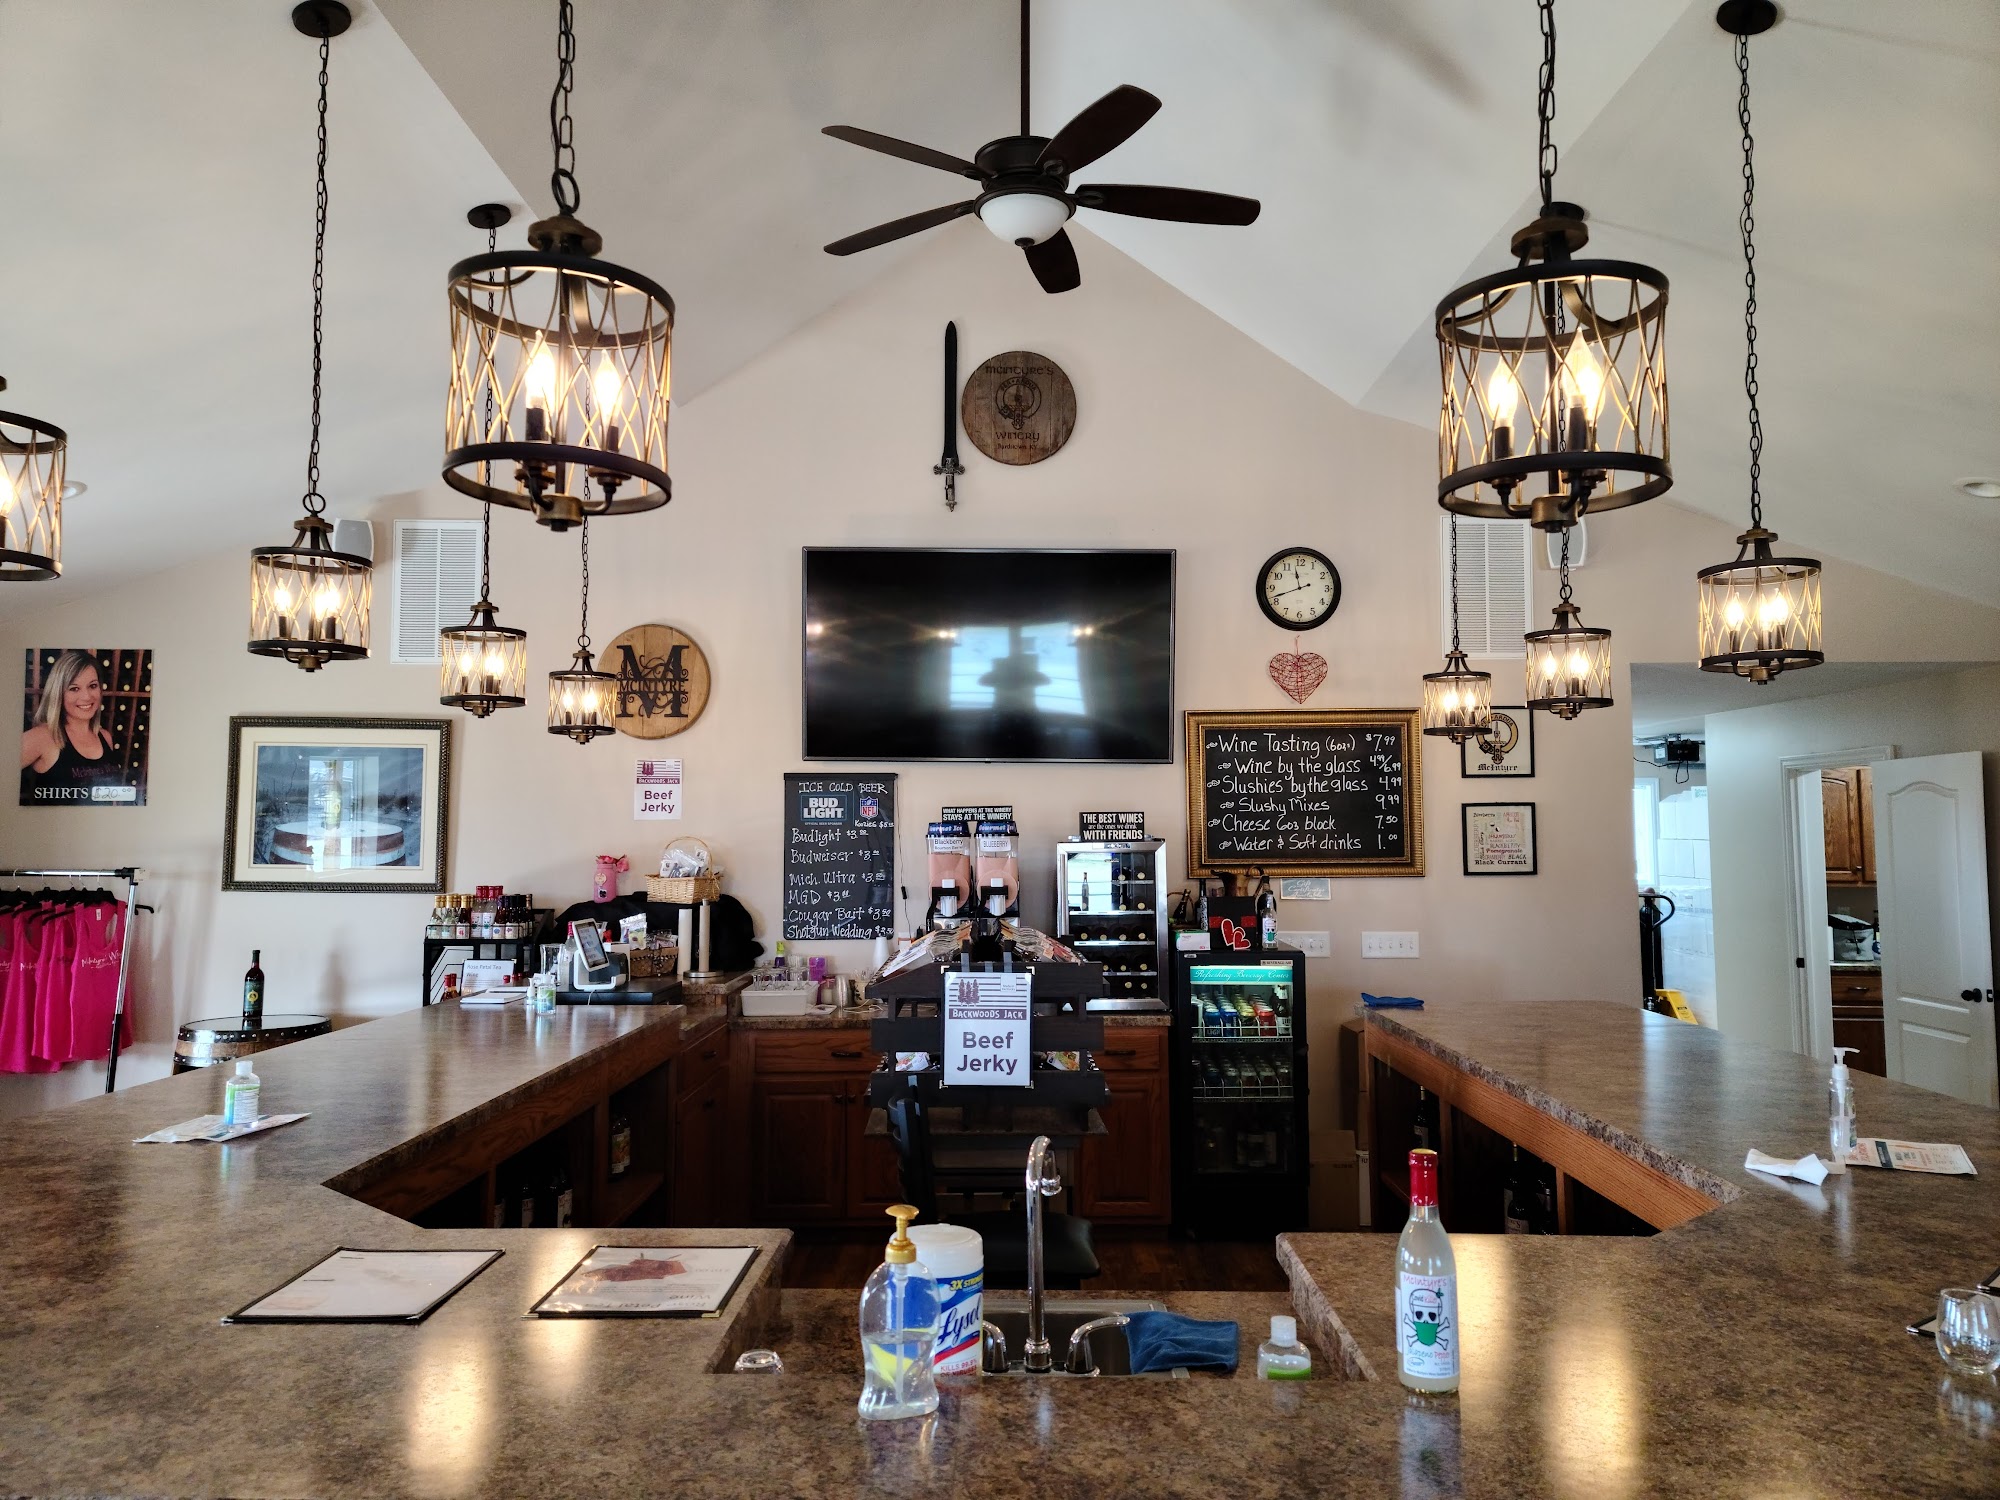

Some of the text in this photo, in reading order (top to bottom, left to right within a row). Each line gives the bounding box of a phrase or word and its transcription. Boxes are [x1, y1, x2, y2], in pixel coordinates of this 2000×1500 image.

[1283, 563, 1291, 571] 11
[1296, 559, 1305, 567] 12
[1311, 562, 1315, 570] 1
[1319, 572, 1326, 580] 2
[619, 680, 686, 692] MCINTYRE
[1217, 733, 1257, 752] Wine
[1263, 732, 1320, 759] Tasting
[1234, 757, 1272, 774] Wine
[1278, 755, 1293, 780] by
[1298, 755, 1321, 773] the
[1325, 756, 1361, 776] glass
[1477, 763, 1518, 772] McIntyre
[798, 782, 888, 794] ICE COLD BEER
[1221, 775, 1283, 794] Slushies
[1330, 775, 1368, 795] glass
[34, 787, 89, 800] SHIRTS
[644, 790, 673, 800] Beef
[641, 802, 675, 814] Jerky
[809, 797, 839, 808] BUD
[1238, 797, 1286, 816] Slushy
[1288, 797, 1330, 812] Mixes
[803, 808, 844, 819] LIGHT
[862, 806, 876, 816] NFL
[943, 813, 963, 821] STAYS
[1083, 813, 1143, 823] THE BEST WINES
[1222, 813, 1270, 832] Cheese
[1304, 814, 1336, 831] block
[791, 827, 841, 847] Budlight
[1083, 830, 1143, 840] WITH FRIENDS
[1233, 835, 1274, 851] Water
[1288, 833, 1317, 850] Soft
[1319, 832, 1362, 850] drinks
[790, 848, 853, 864] Budweiser
[823, 871, 856, 884] Ultra
[787, 889, 821, 905] MGD
[788, 908, 833, 927] Cougar
[834, 906, 865, 920] Bait
[787, 924, 829, 939] Shotgun
[831, 923, 872, 940] Wedding
[1194, 969, 1232, 983] Refreshing
[952, 1009, 1023, 1019] BACKWOODS JACK
[962, 1031, 1014, 1049] Beef
[956, 1054, 1018, 1076] Jerky
[950, 1280, 964, 1291] 3X
[937, 1293, 982, 1346] Lysol
[940, 1362, 960, 1371] KILLS
